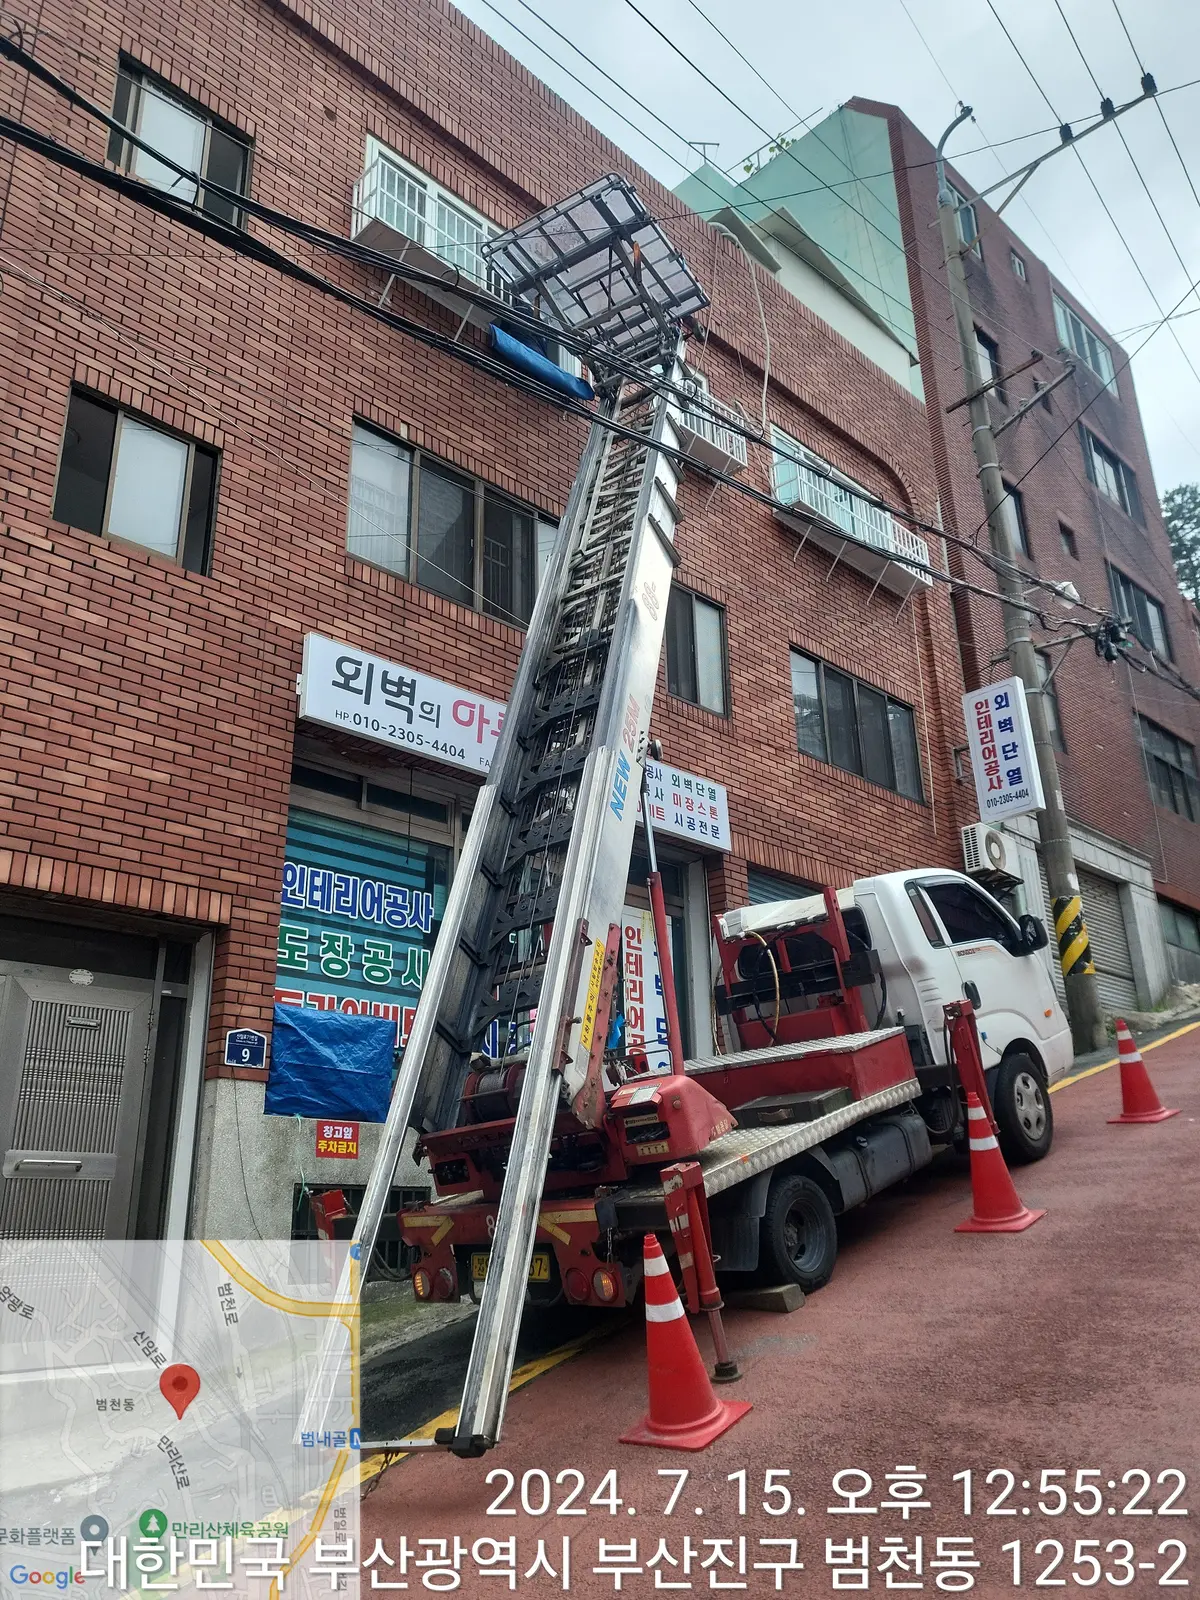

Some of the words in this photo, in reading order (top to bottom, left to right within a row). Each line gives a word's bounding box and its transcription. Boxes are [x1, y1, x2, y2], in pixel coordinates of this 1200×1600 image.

[332, 656, 441, 728] 외벽의
[974, 699, 1003, 792] 인테리어공사
[994, 691, 1024, 786] 외벽단열
[609, 749, 631, 821] NEW
[623, 694, 642, 754] 25M
[671, 774, 717, 802] 외벽단열
[986, 788, 1030, 808] 010-2305-4404
[672, 792, 718, 820] 미장스톤
[674, 812, 720, 840] 시공전문
[281, 861, 434, 933] 인테리어공사
[241, 1048, 250, 1062] 9
[323, 1125, 353, 1139] 창고앞
[318, 1140, 357, 1154] 주차금지
